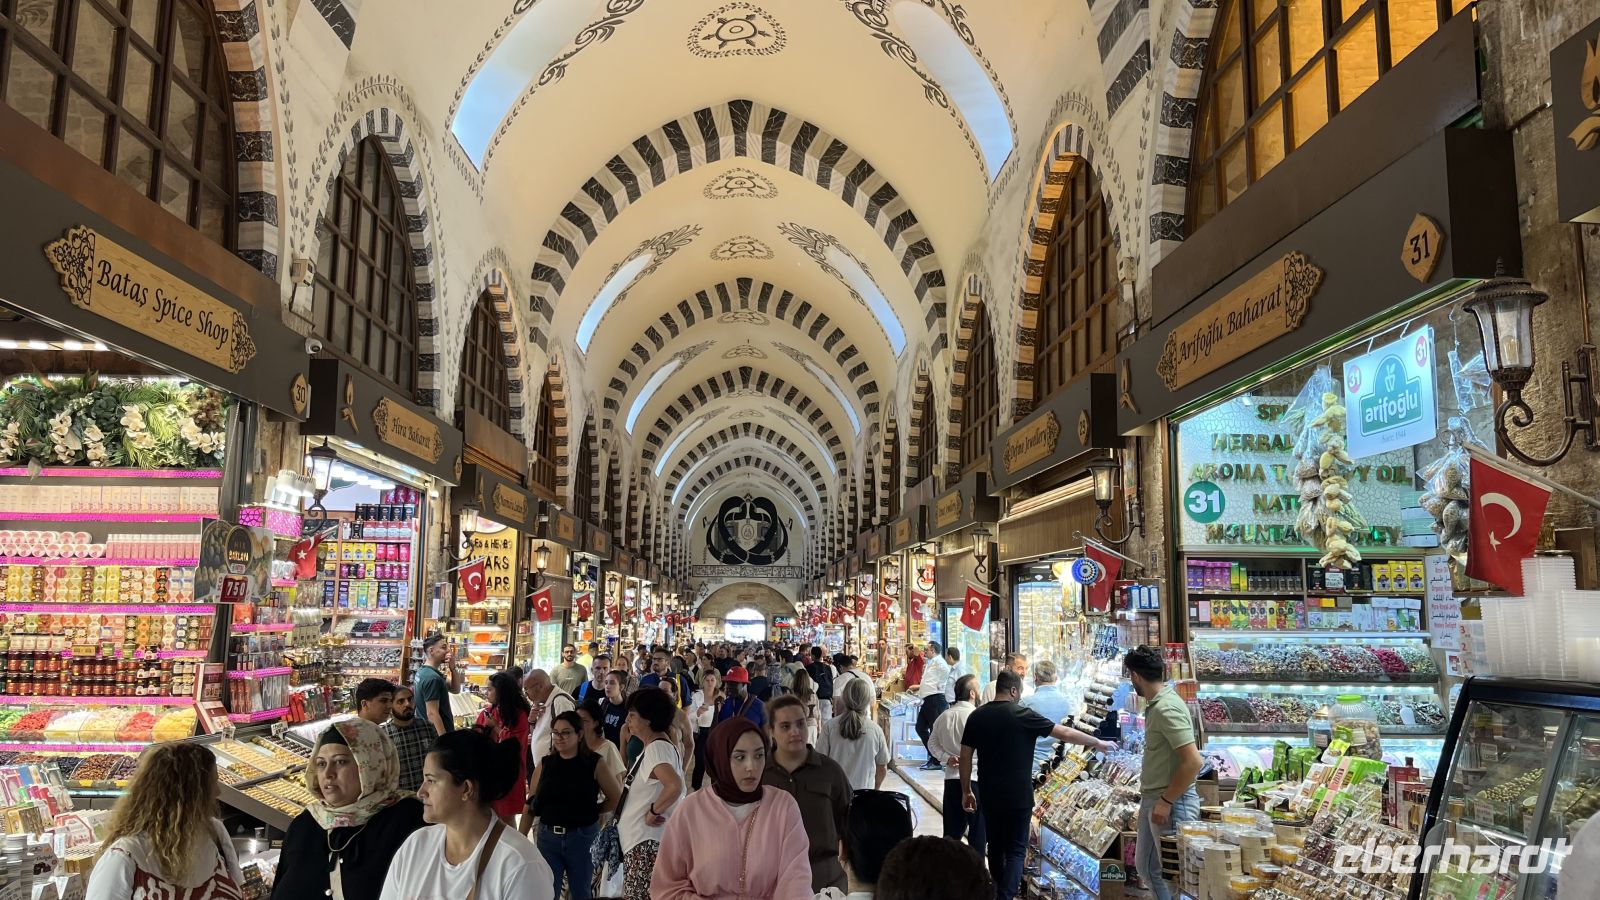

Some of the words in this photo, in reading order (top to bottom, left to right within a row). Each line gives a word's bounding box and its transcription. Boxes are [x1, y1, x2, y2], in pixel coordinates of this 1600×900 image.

[1410, 230, 1430, 265] 31
[97, 259, 149, 308] Bataş
[152, 288, 192, 326] Spice
[196, 310, 229, 350] Shop
[1177, 318, 1223, 365] Arifoğlu
[1226, 283, 1282, 337] Baharat
[1416, 343, 1427, 361] 31
[1348, 369, 1360, 388] 31
[295, 384, 306, 404] 30
[1365, 389, 1418, 423] arifoğlu
[1211, 433, 1294, 452] HERBAL
[1188, 463, 1266, 482] AROMA
[1375, 465, 1413, 482] OIL
[1188, 489, 1221, 514] 31
[226, 581, 246, 597] 750
